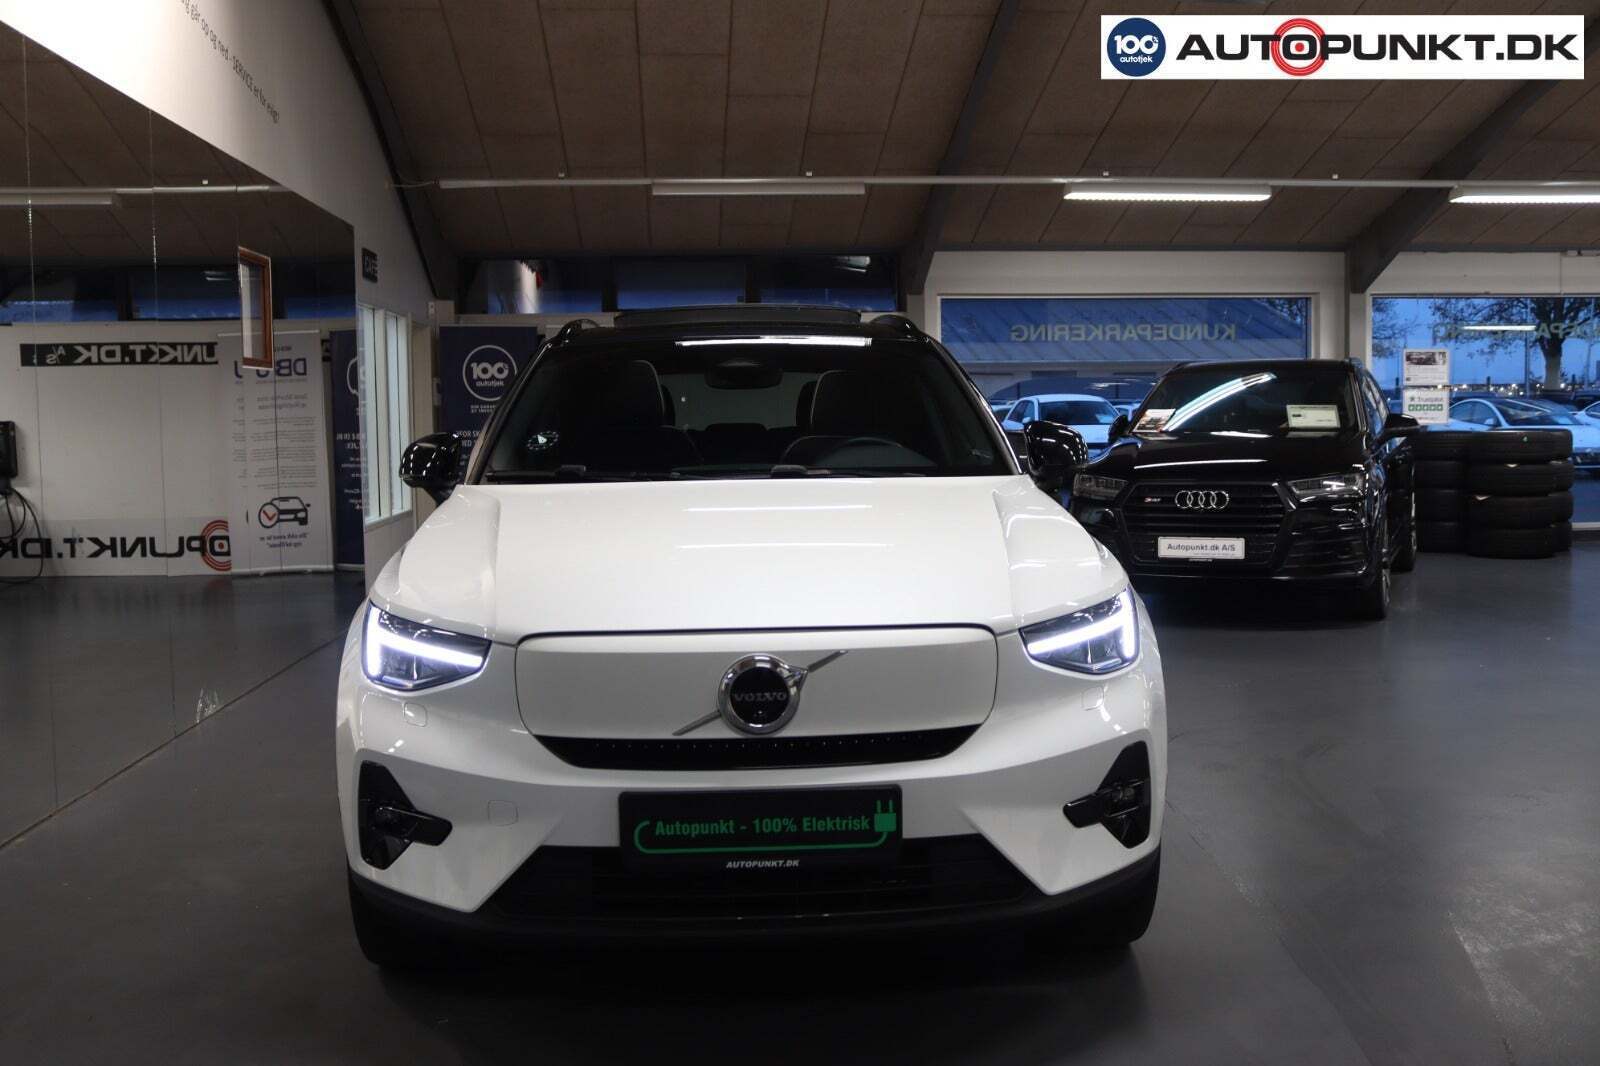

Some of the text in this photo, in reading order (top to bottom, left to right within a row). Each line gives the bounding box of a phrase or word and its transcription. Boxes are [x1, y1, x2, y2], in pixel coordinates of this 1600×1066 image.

[232, 55, 254, 92] SERVICE
[1168, 543, 1236, 553] Autopunkt.dk A/S
[734, 691, 788, 702] VOLVO
[655, 819, 736, 838] Autopunkt
[752, 817, 797, 833] 100%
[802, 815, 870, 833] Elektrisk
[726, 859, 800, 869] AUTOPUNKT.DK
